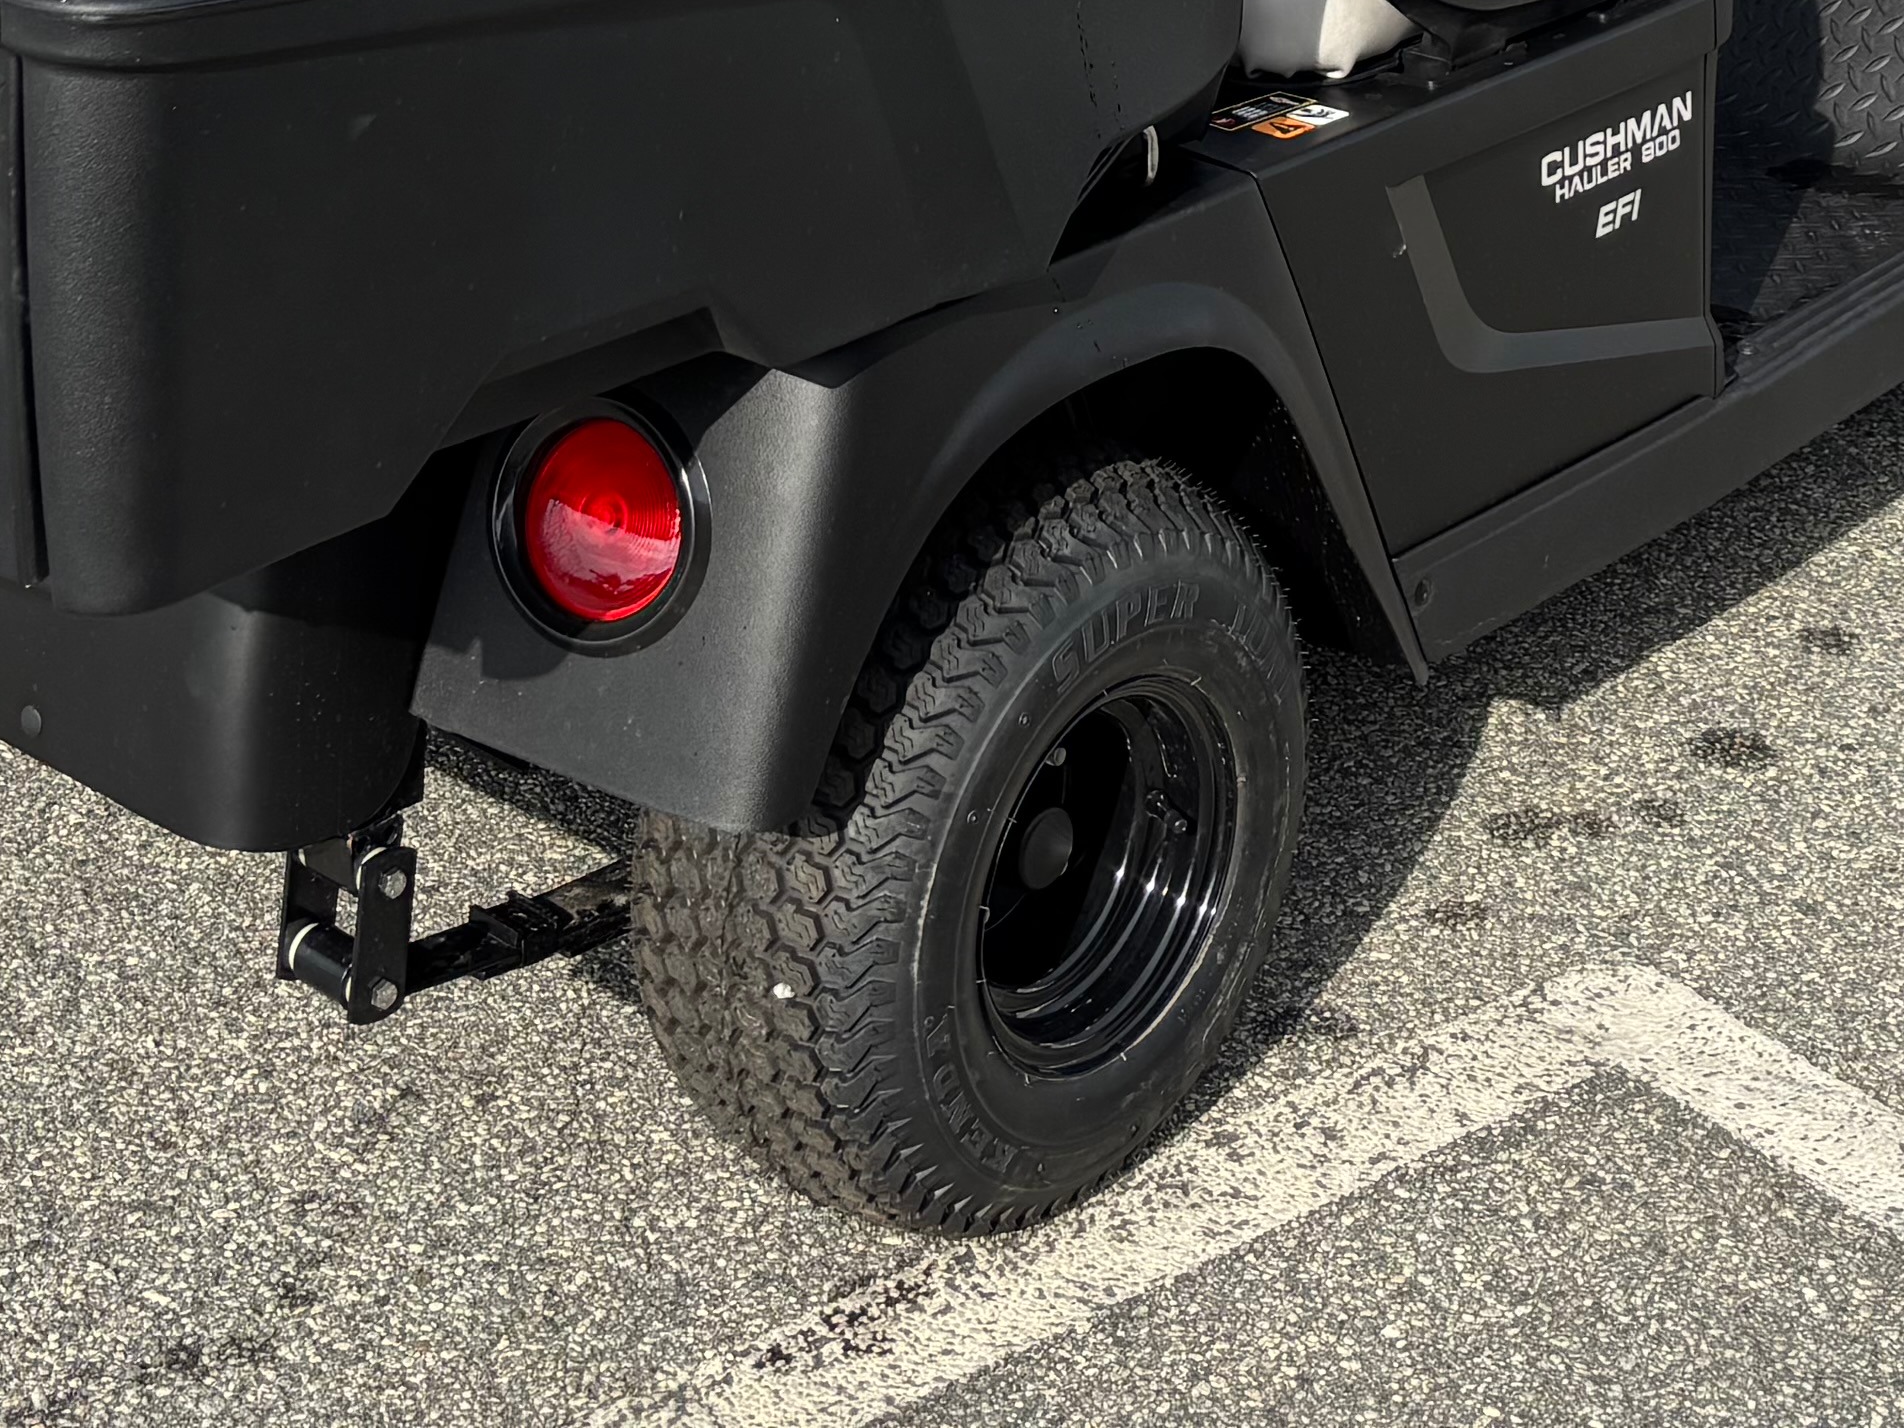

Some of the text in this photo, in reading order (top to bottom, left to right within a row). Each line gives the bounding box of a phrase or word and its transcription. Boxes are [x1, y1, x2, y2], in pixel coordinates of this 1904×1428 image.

[1541, 91, 1692, 187] CUSHMAN
[1555, 151, 1632, 203] HAULER
[1595, 189, 1642, 239] EFI
[1051, 579, 1200, 694] SUPER
